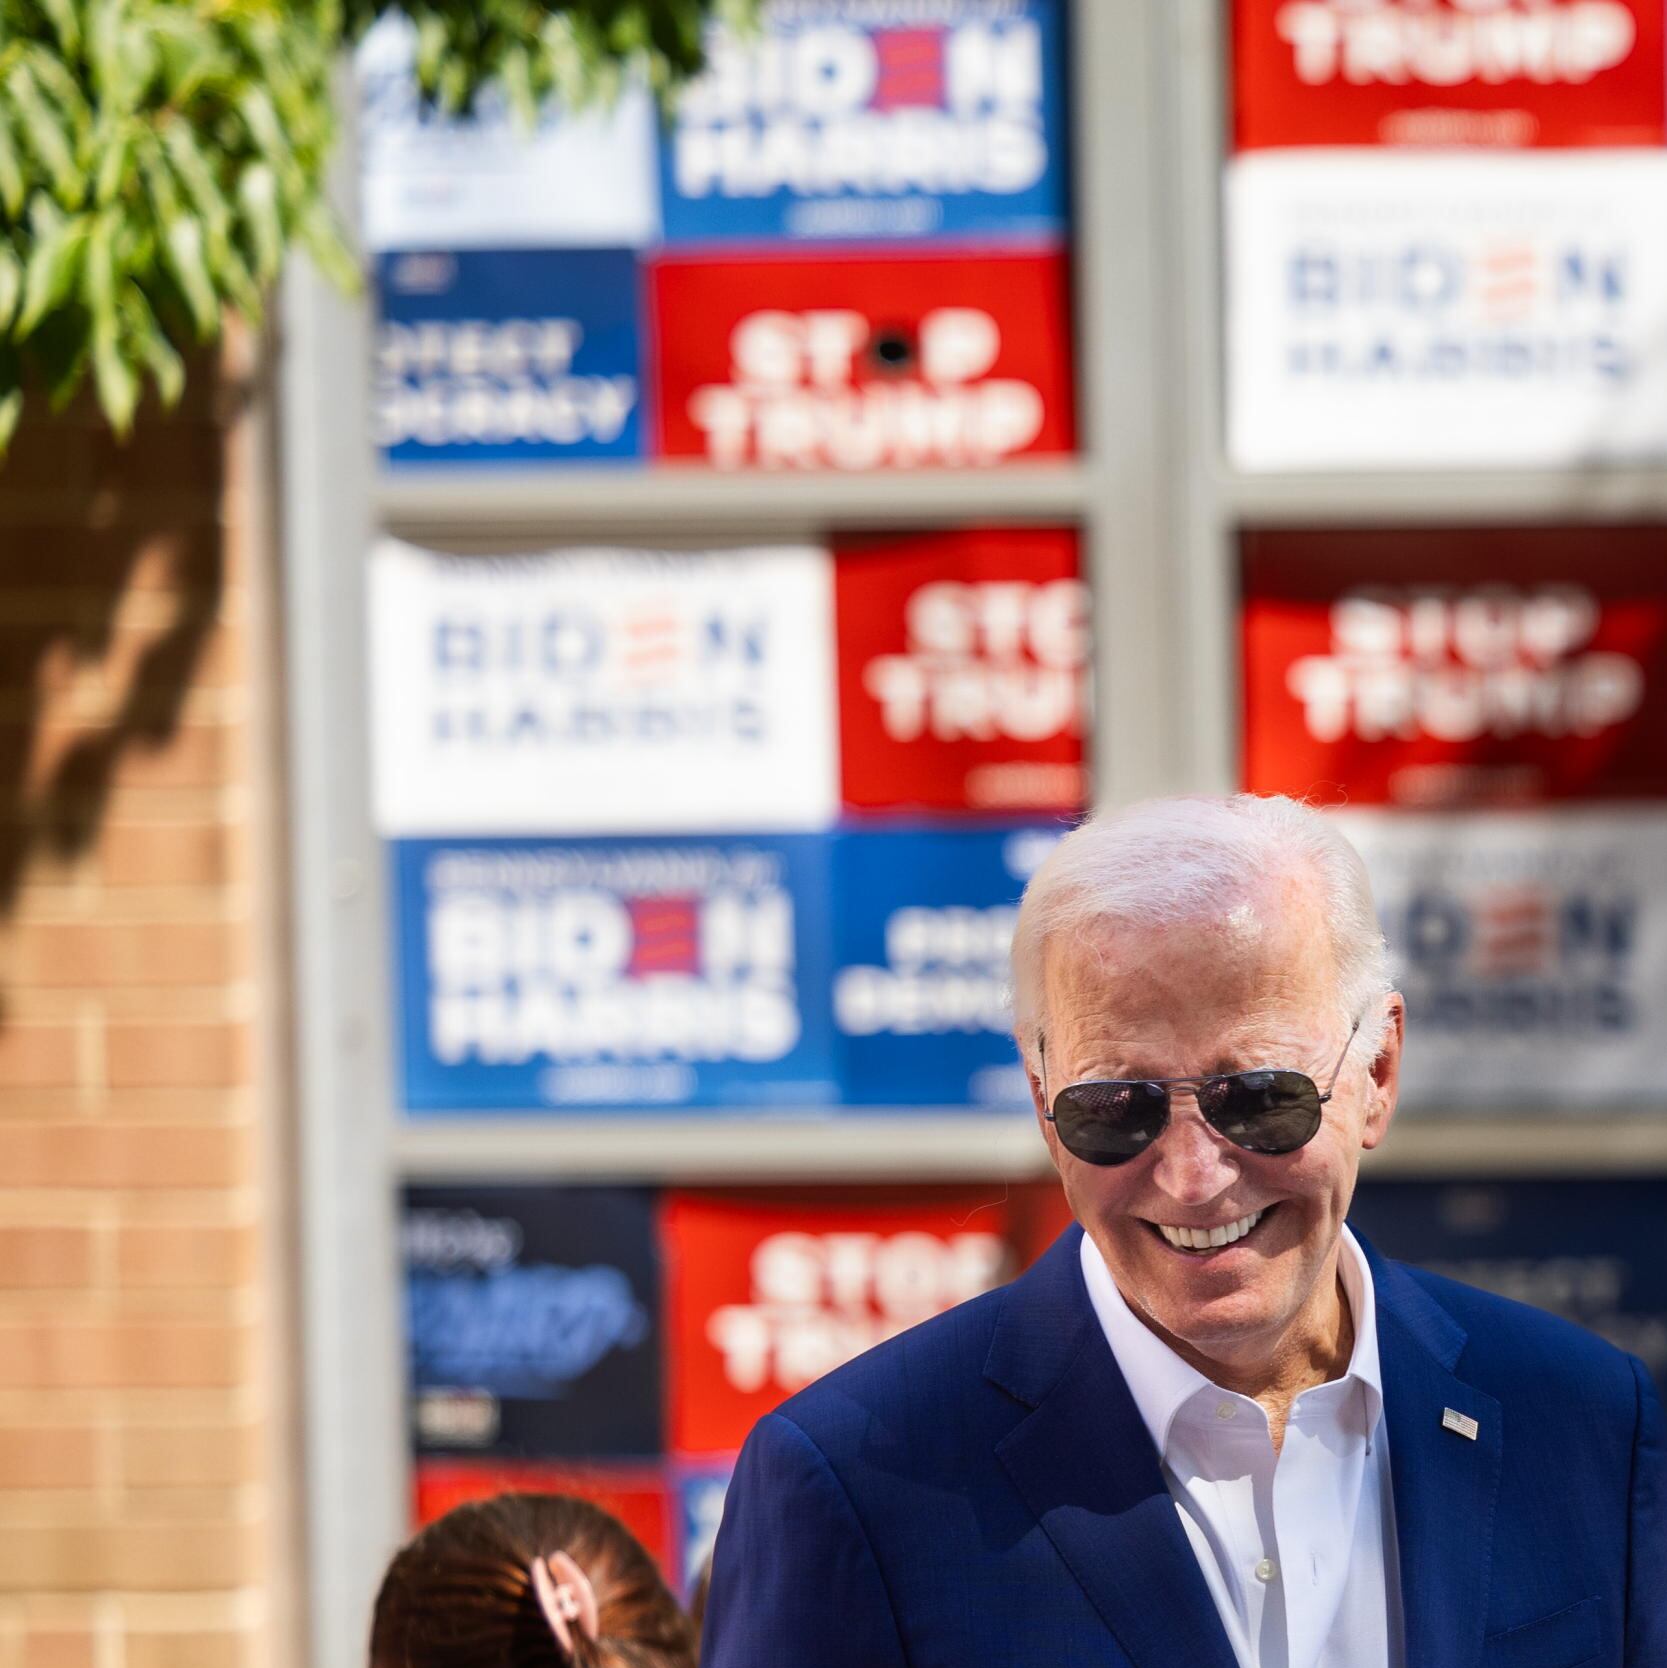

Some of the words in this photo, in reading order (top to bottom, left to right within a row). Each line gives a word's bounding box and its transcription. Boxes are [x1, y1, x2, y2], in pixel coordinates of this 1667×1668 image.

[675, 116, 1048, 197] HARRIS
[1285, 248, 1630, 318] BIDEN
[1285, 332, 1632, 382] HARRIS
[688, 380, 1046, 468] TRUMP
[430, 611, 767, 680] BIDEN
[1328, 586, 1600, 658] STOP
[430, 701, 767, 745] HARRIS
[1284, 652, 1645, 742] TRUMP
[428, 888, 796, 980] BIDEN
[430, 980, 800, 1064] HARRIS
